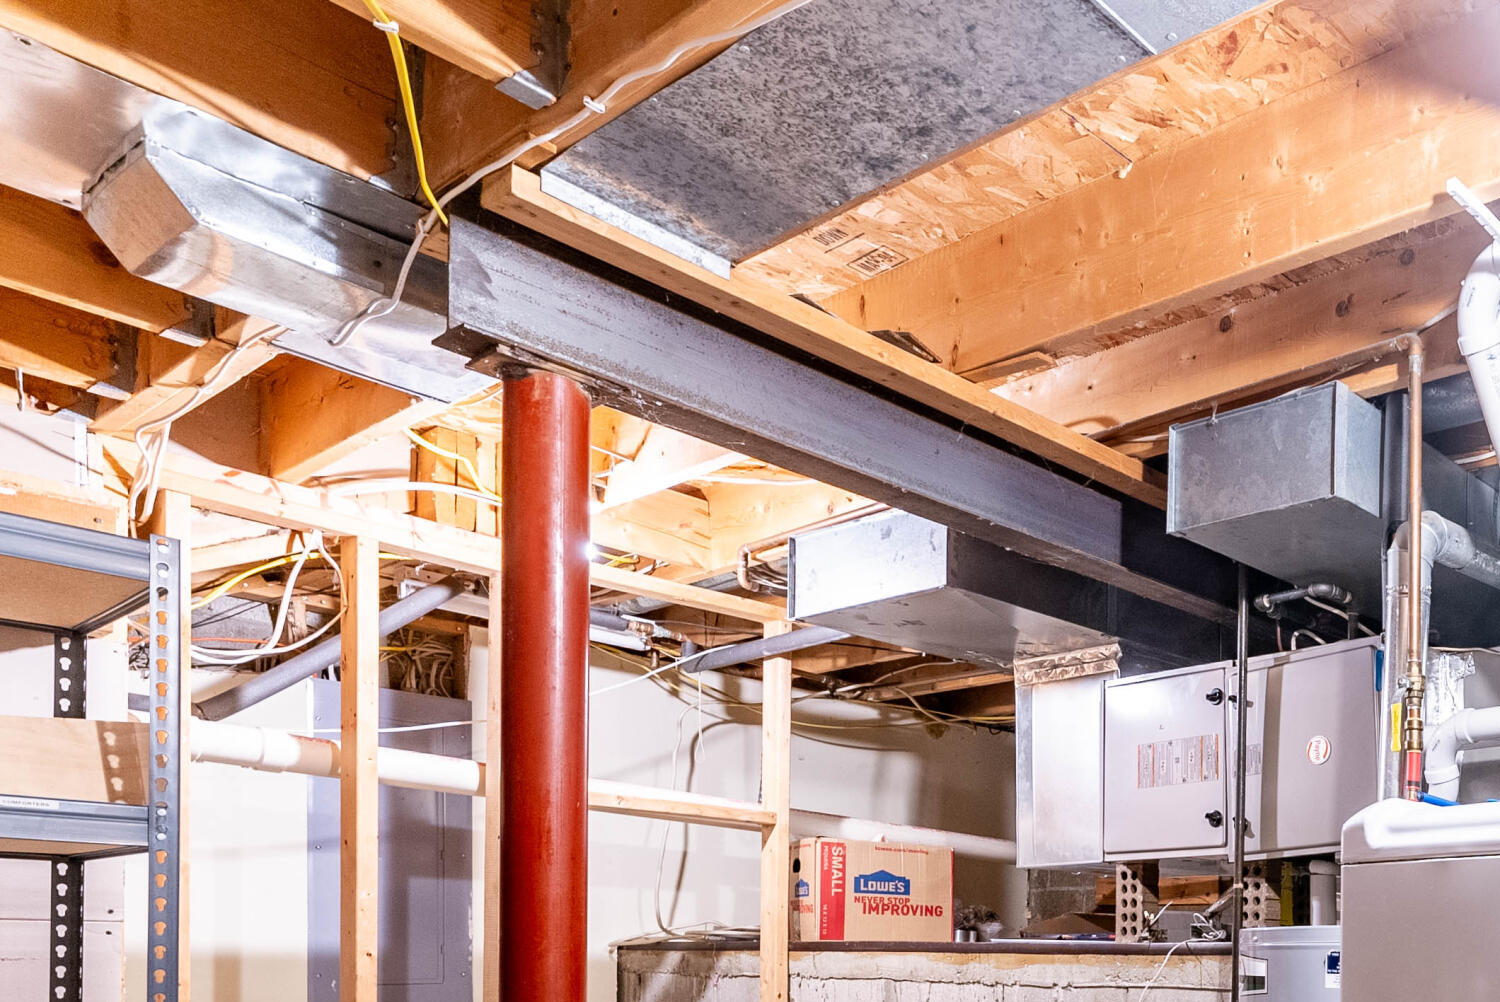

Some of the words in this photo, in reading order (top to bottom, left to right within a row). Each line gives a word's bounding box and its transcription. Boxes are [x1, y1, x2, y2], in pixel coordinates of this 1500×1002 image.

[812, 226, 849, 246] DOWN
[831, 846, 844, 897] SMALL
[860, 879, 905, 893] LOWE'S
[854, 896, 884, 904] NEVER
[887, 897, 911, 905] STOP
[862, 902, 944, 917] IMPROVING
